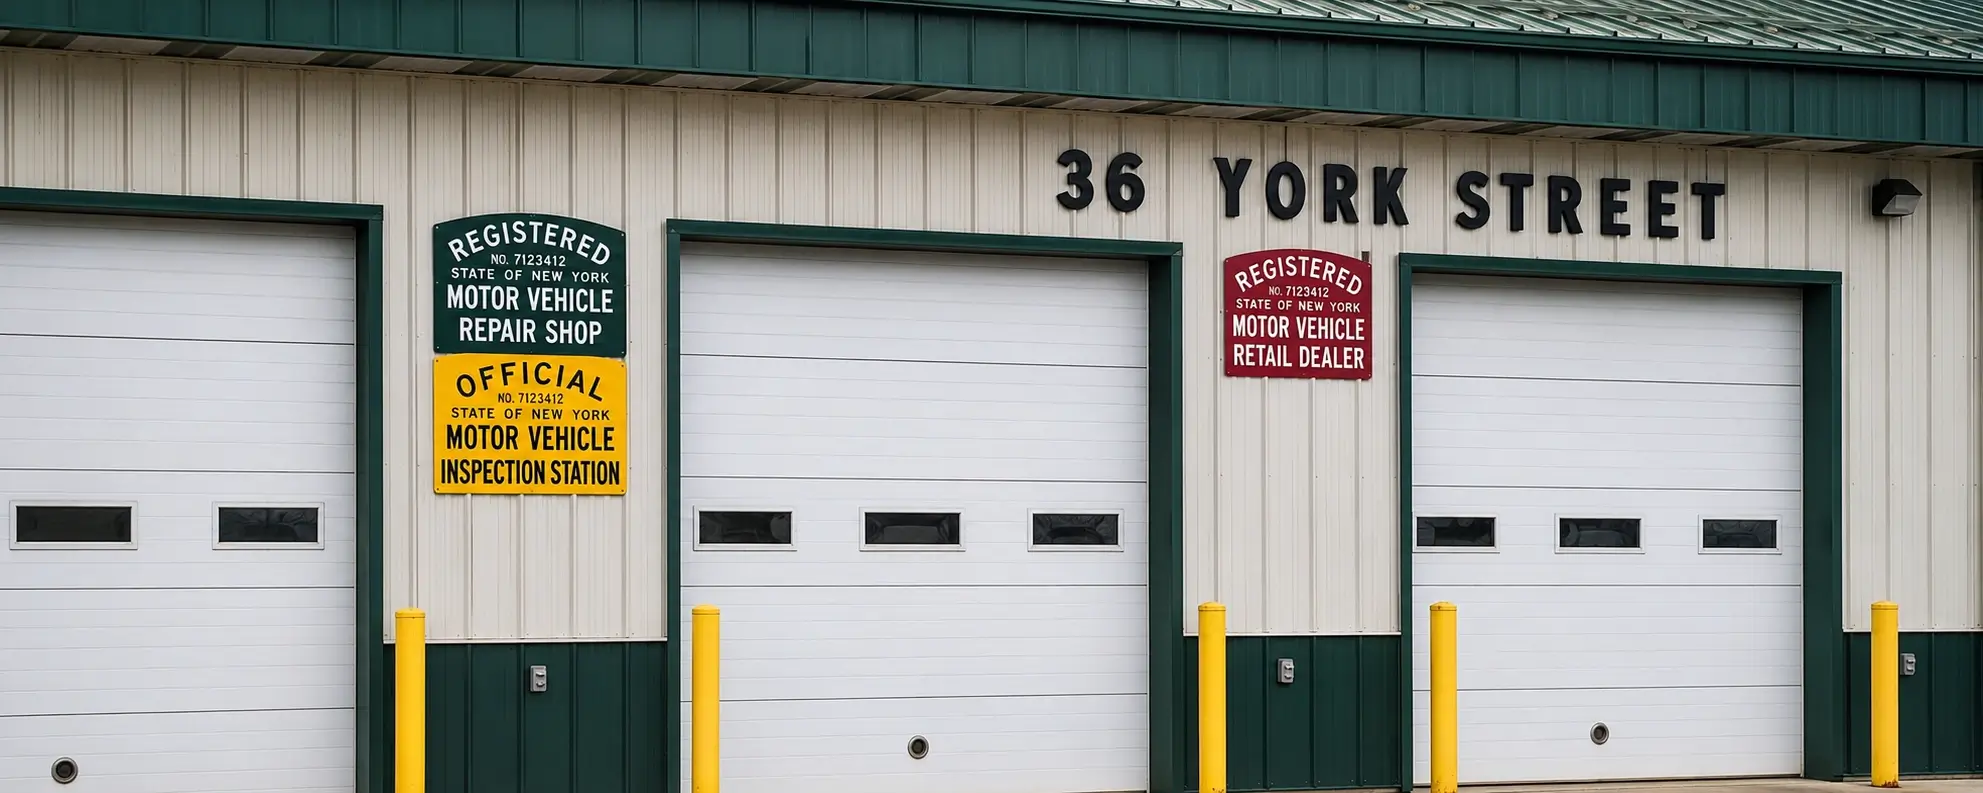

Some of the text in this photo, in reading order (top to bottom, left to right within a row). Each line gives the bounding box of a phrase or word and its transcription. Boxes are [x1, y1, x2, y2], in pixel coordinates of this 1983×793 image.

[1055, 148, 1725, 240] 36 YORK STREET
[448, 221, 610, 265] REGISTERED
[491, 254, 566, 267] NO. 7123412
[451, 268, 609, 283] STATE OF NEW YORK
[1234, 255, 1362, 295] REGISTERED
[447, 284, 614, 313] MOTOR VEHICLE
[1268, 286, 1329, 297] NO. 7123412
[1236, 298, 1360, 313] STATE OF NEW YORK
[459, 317, 602, 344] REPAIR SHOP
[1233, 314, 1365, 340] MOTOR VEHICLE
[1233, 343, 1364, 369] RETAIL DEALER
[456, 361, 603, 402] OFFICIAL
[498, 393, 563, 404] NO. 7123412
[451, 407, 610, 421] STATE OF NEW YORK
[446, 424, 615, 451] MOTOR VEHICLE
[441, 459, 620, 485] INSPECTION STATION
